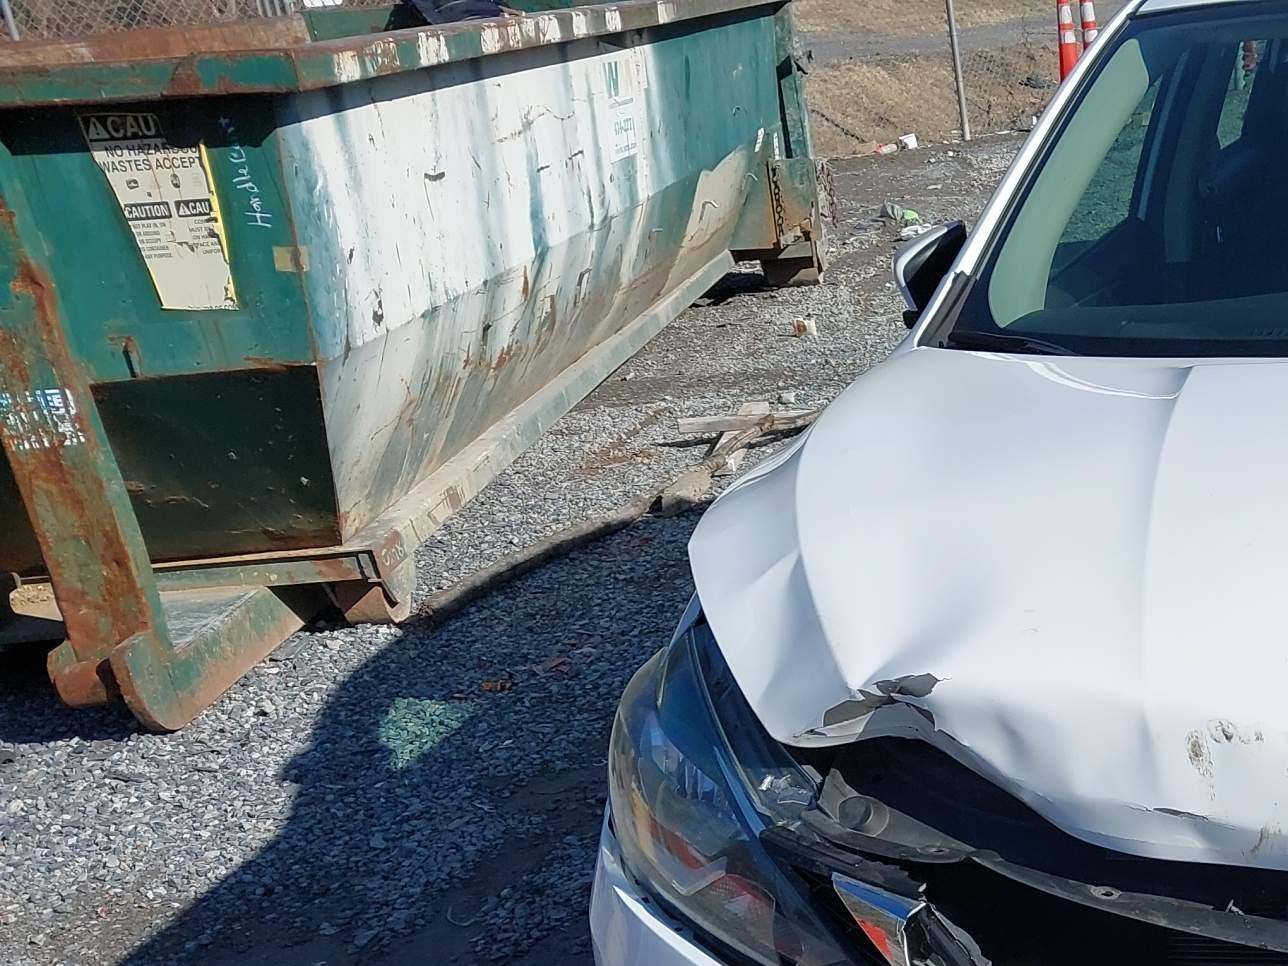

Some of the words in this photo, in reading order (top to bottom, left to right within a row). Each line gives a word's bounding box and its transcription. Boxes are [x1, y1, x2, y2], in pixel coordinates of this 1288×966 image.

[104, 144, 125, 158] NO
[101, 158, 152, 173] WASTES
[125, 204, 169, 219] CAUTION
[188, 201, 211, 214] CAU
